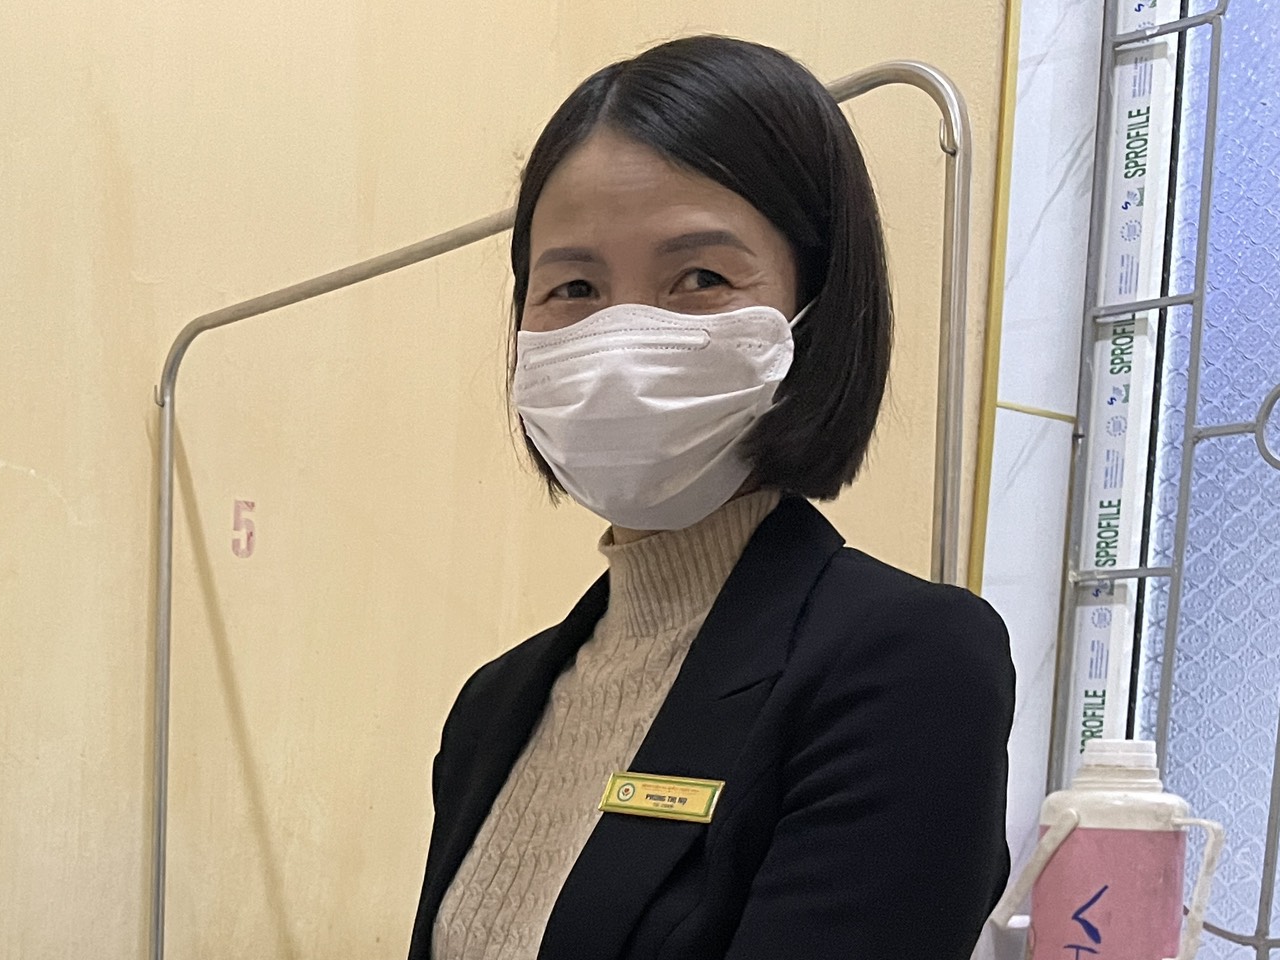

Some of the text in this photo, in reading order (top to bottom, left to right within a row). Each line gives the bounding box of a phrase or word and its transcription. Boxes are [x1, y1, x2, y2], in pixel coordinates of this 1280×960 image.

[1124, 106, 1151, 179] SPROFILE
[1109, 312, 1135, 375] SPROFIL
[232, 500, 255, 558] 5
[1095, 499, 1121, 567] SPROFILE
